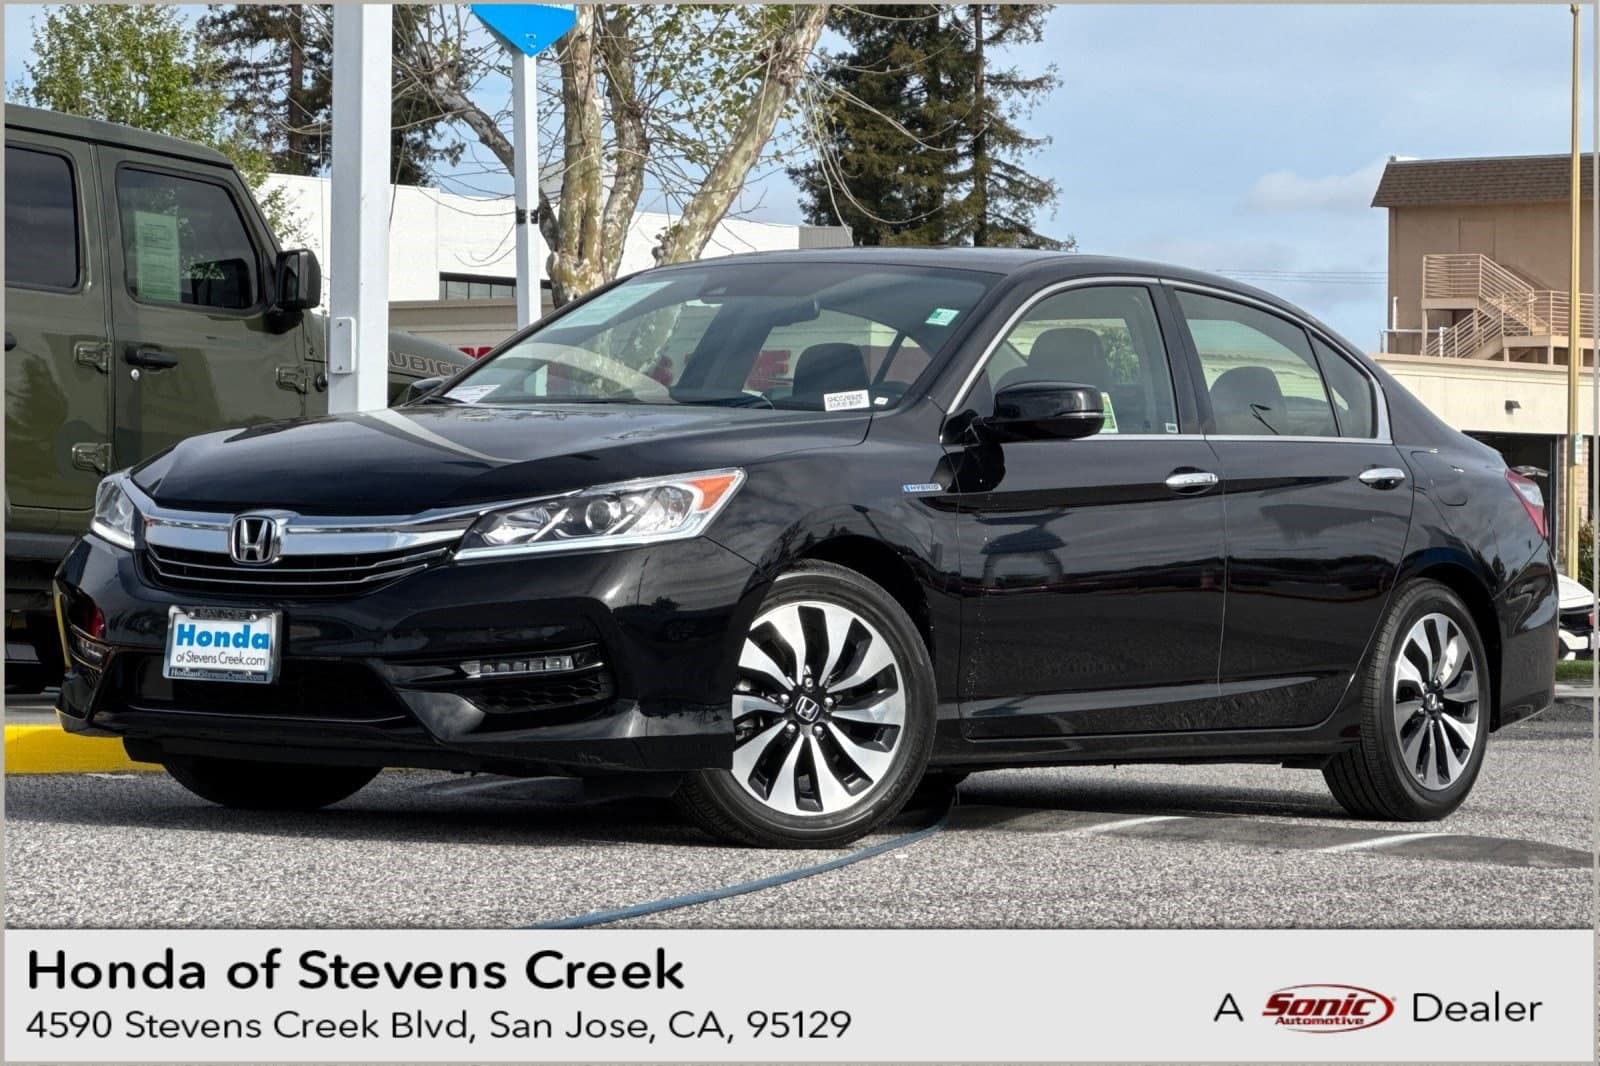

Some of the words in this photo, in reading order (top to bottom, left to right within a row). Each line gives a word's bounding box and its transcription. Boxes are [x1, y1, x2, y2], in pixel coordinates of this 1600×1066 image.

[389, 352, 465, 377] UBIC
[176, 623, 270, 650] Honda
[176, 652, 186, 663] of
[186, 650, 217, 664] Stevens
[218, 651, 266, 667] Creek.com
